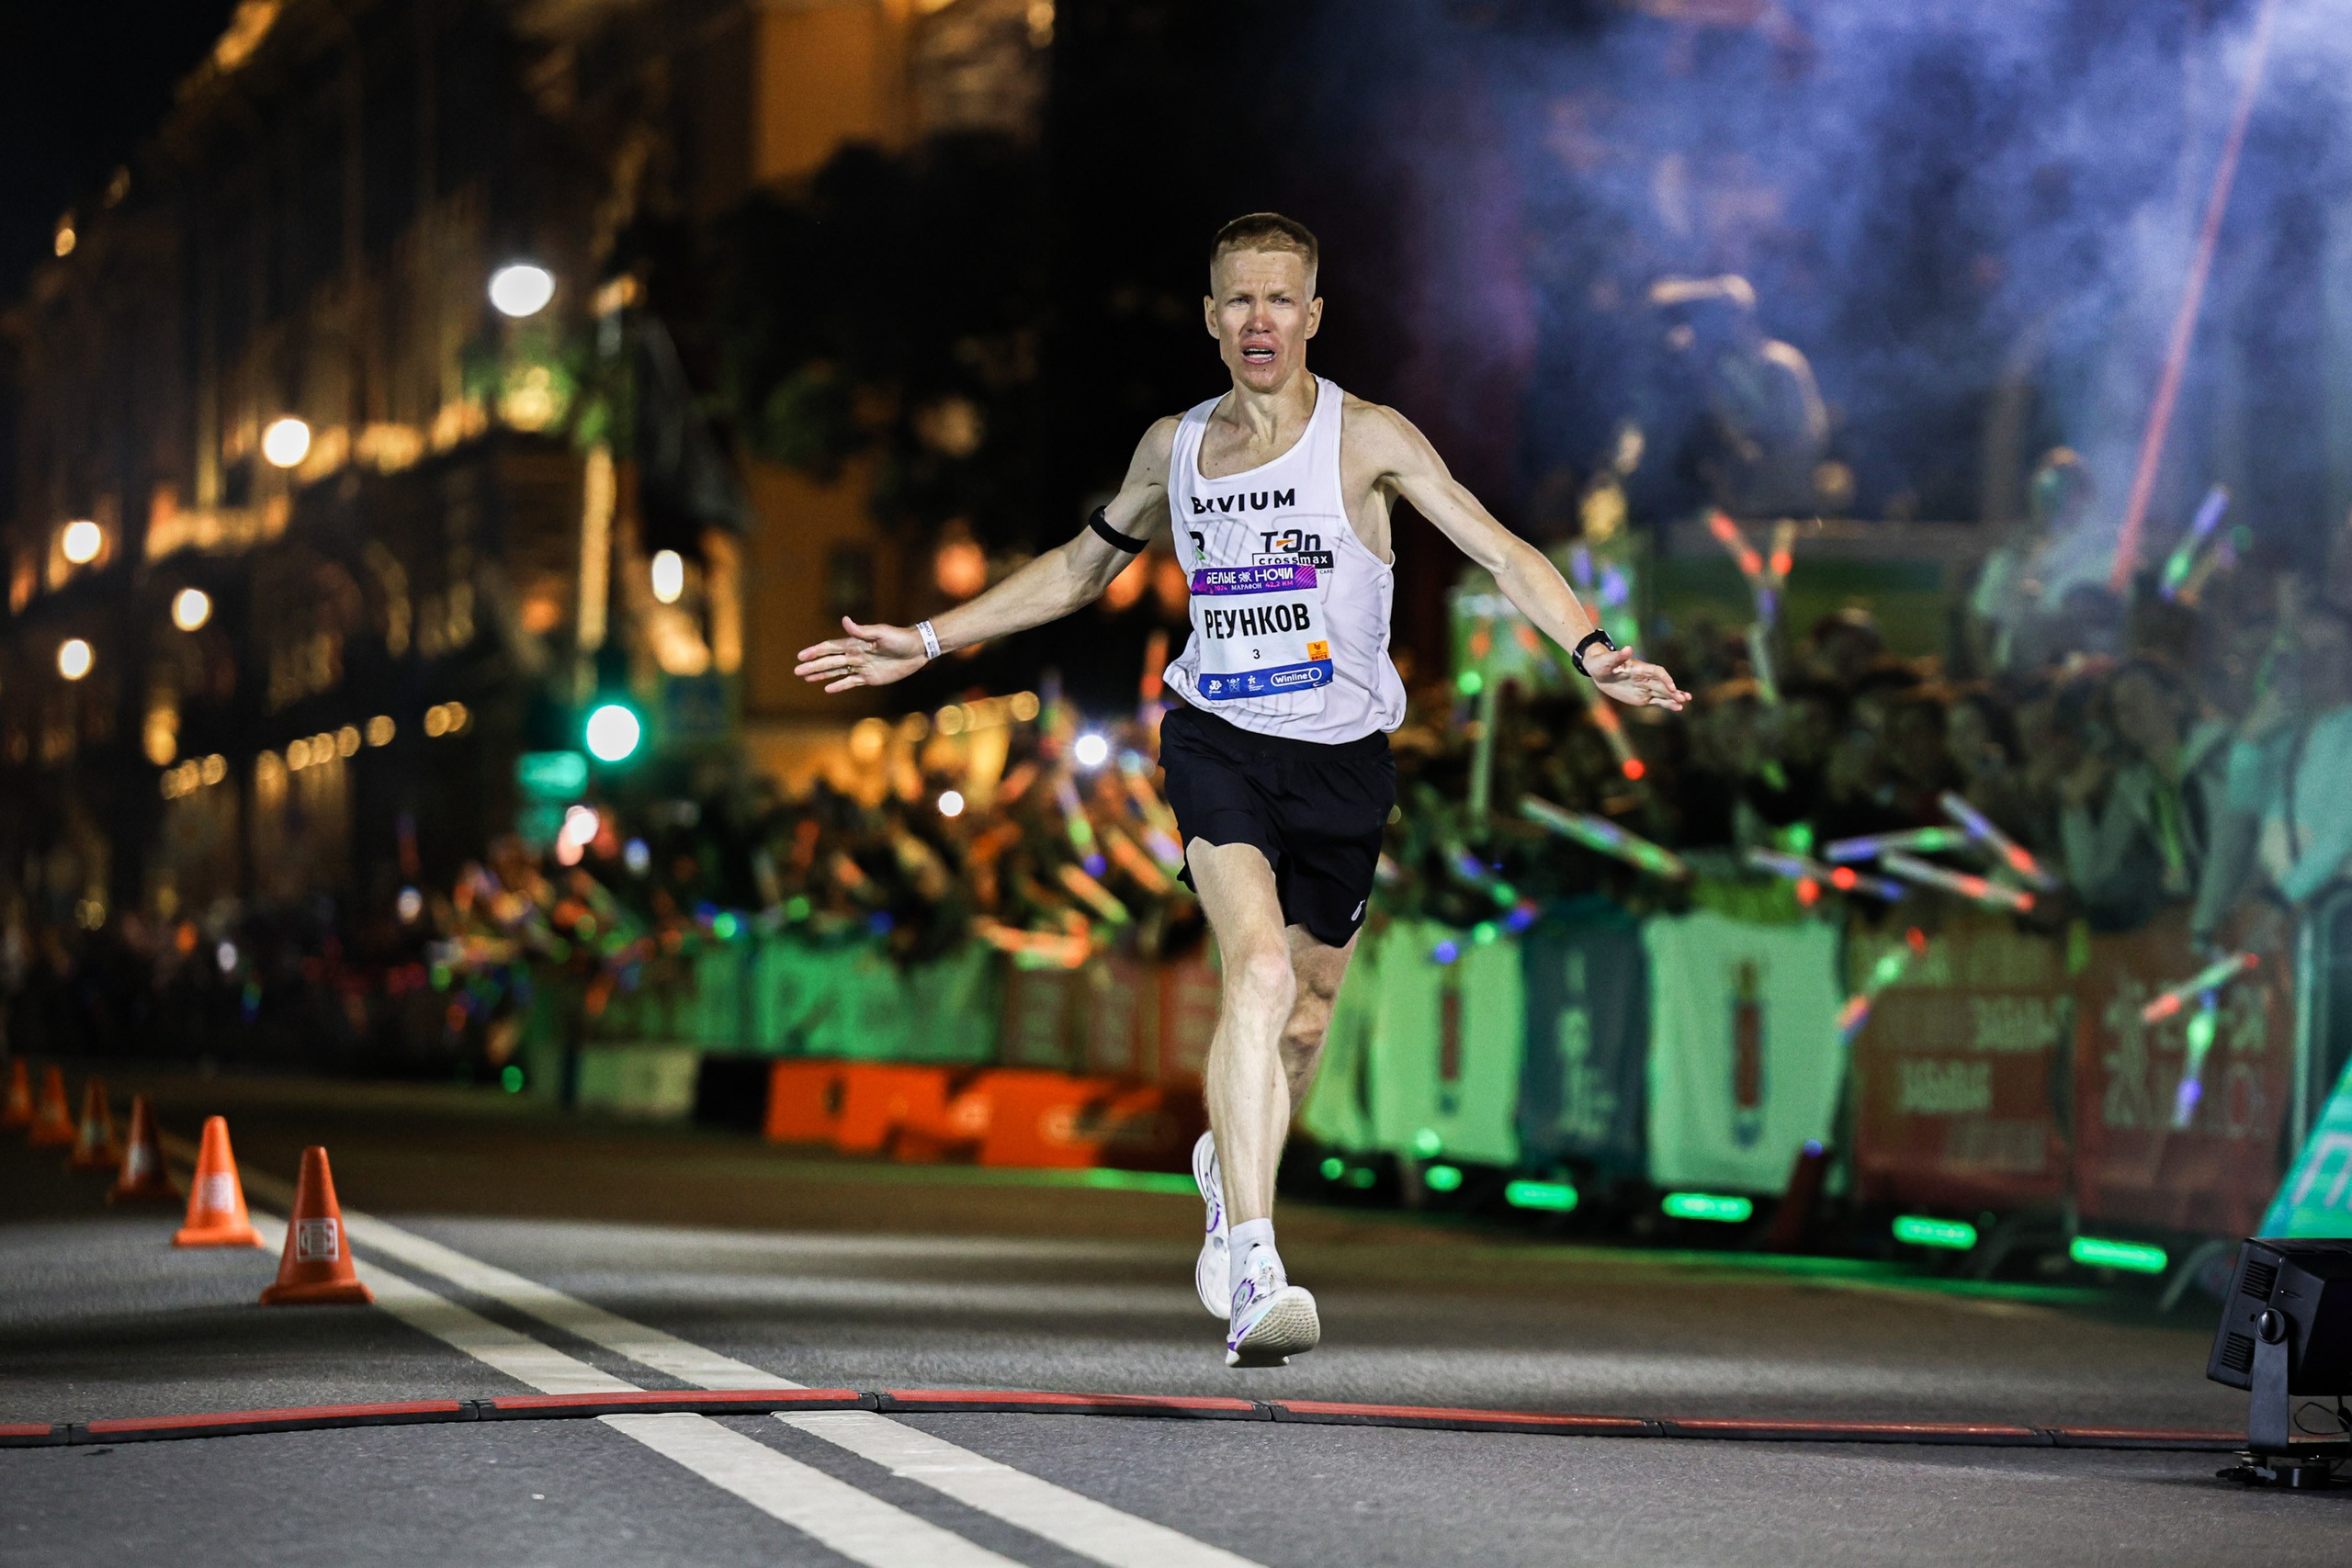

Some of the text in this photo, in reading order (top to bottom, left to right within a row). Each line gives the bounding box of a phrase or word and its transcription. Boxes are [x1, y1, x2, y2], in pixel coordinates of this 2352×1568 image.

[1259, 555, 1329, 566] crossmax
[1255, 567, 1294, 582] НОЧИ
[1231, 582, 1262, 591] МАРАФОН
[1204, 604, 1311, 639] РЕУНКОВ
[1252, 649, 1261, 660] 3
[1275, 672, 1308, 683] Winline
